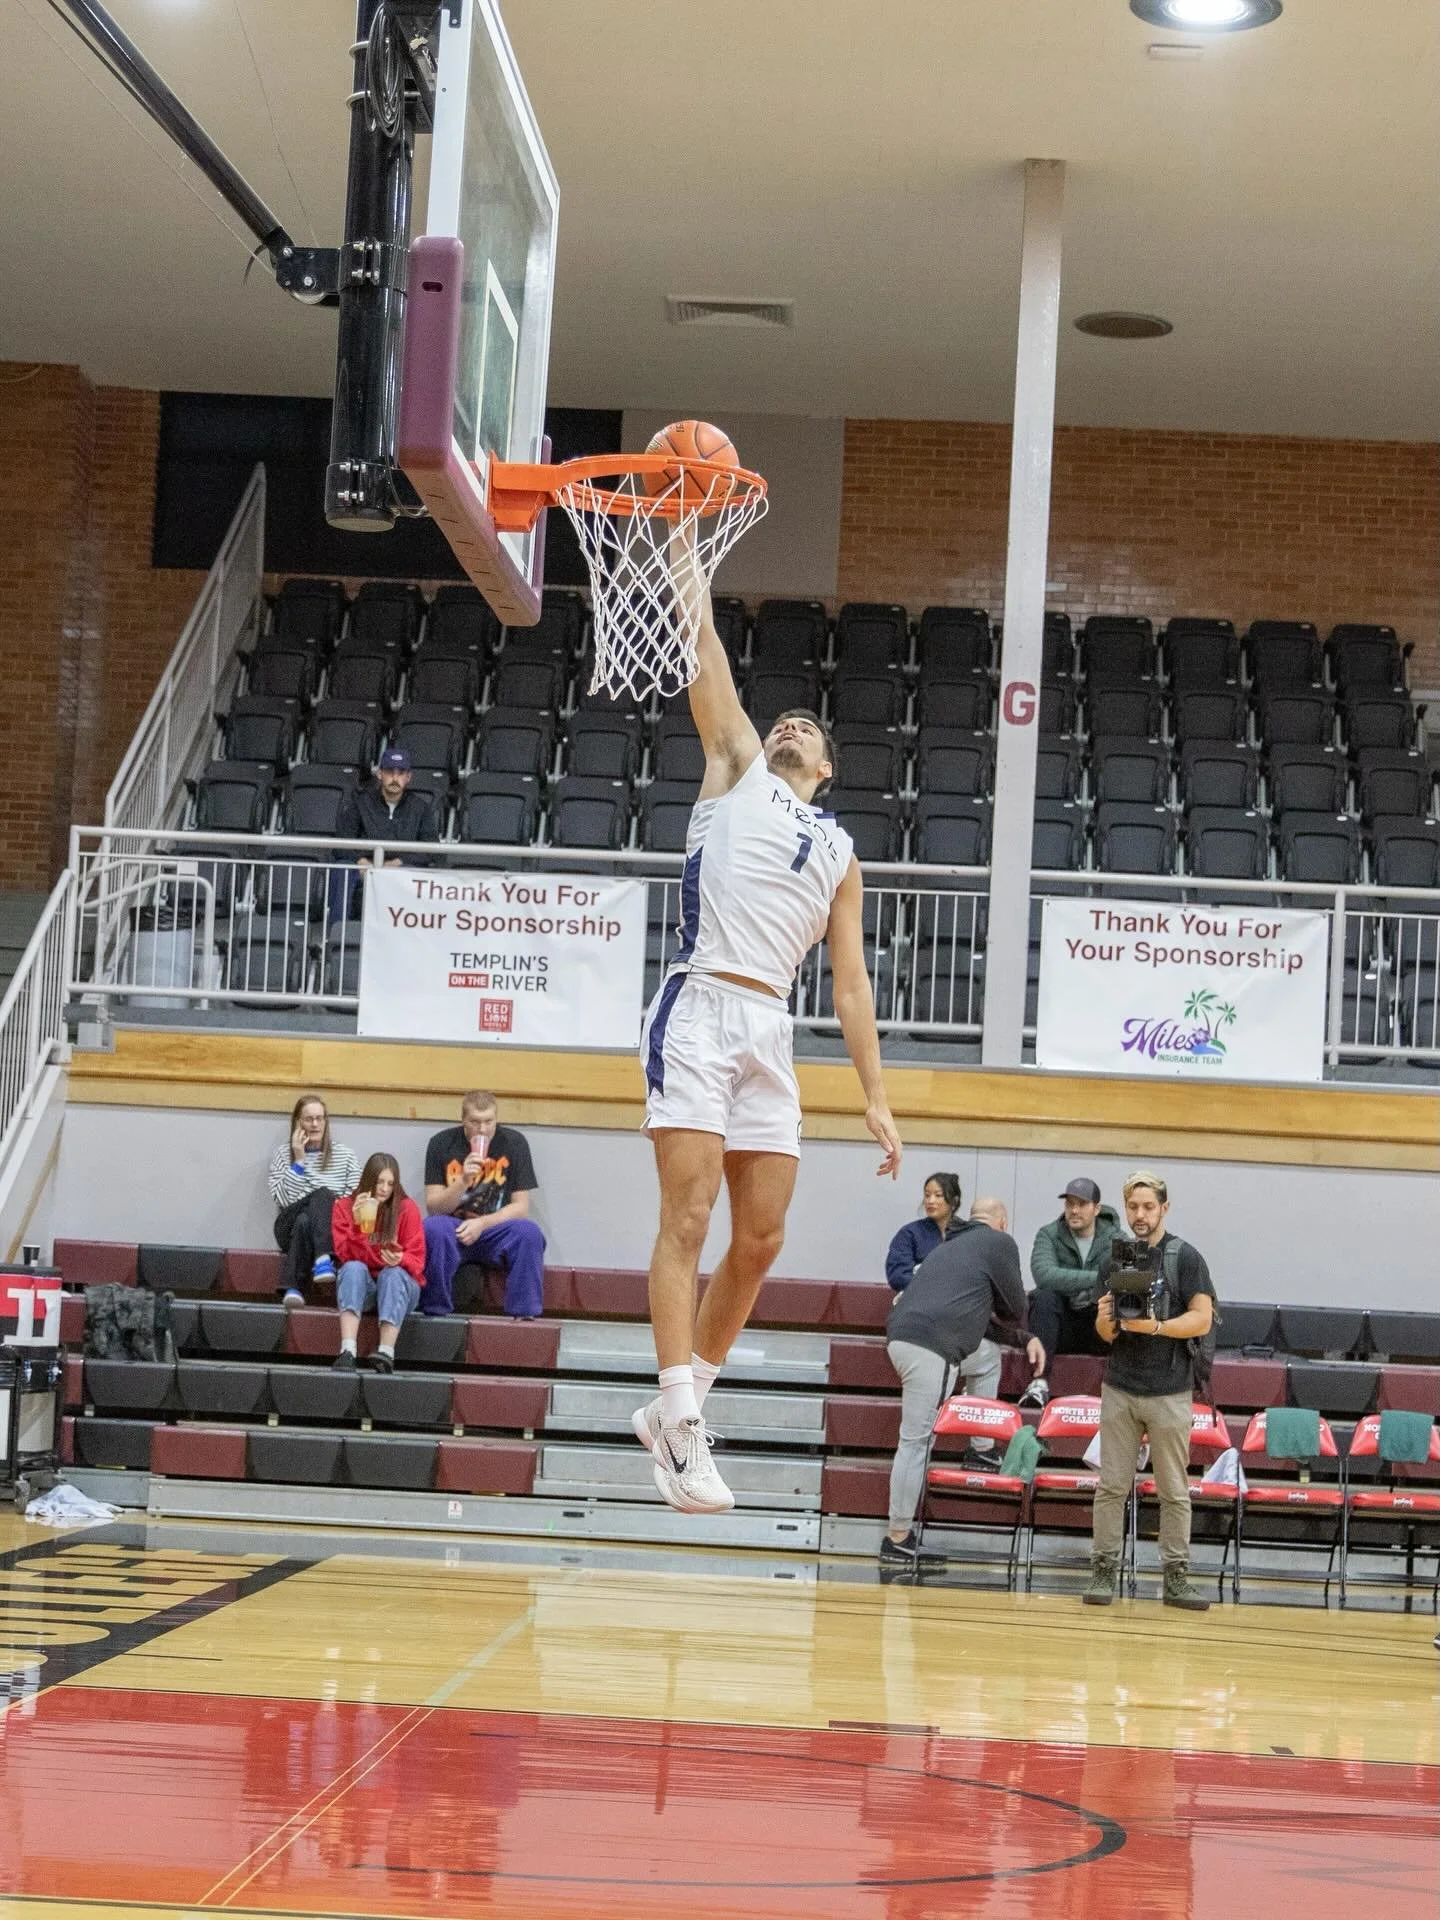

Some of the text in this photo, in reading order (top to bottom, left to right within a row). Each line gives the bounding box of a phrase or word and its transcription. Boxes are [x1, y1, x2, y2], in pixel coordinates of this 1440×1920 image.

[1003, 681, 1036, 725] G
[412, 879, 600, 906] Thank You For
[388, 906, 622, 942] Your Sponsorship
[1089, 909, 1282, 939] Thank You For
[450, 952, 549, 972] TEMPLIN'S
[1065, 938, 1303, 975] Your Sponsorship
[451, 974, 548, 992] ON THE RIVER
[484, 1003, 508, 1014] RED
[484, 1013, 508, 1023] LION
[1121, 1018, 1194, 1060] Miles
[1157, 1054, 1223, 1065] INSURANCE TEAM
[948, 1403, 1015, 1418] NORTH IDAHO
[958, 1413, 1005, 1425] COLLEGE
[1051, 1406, 1084, 1416] NORTH
[1061, 1415, 1100, 1425] COLLEG
